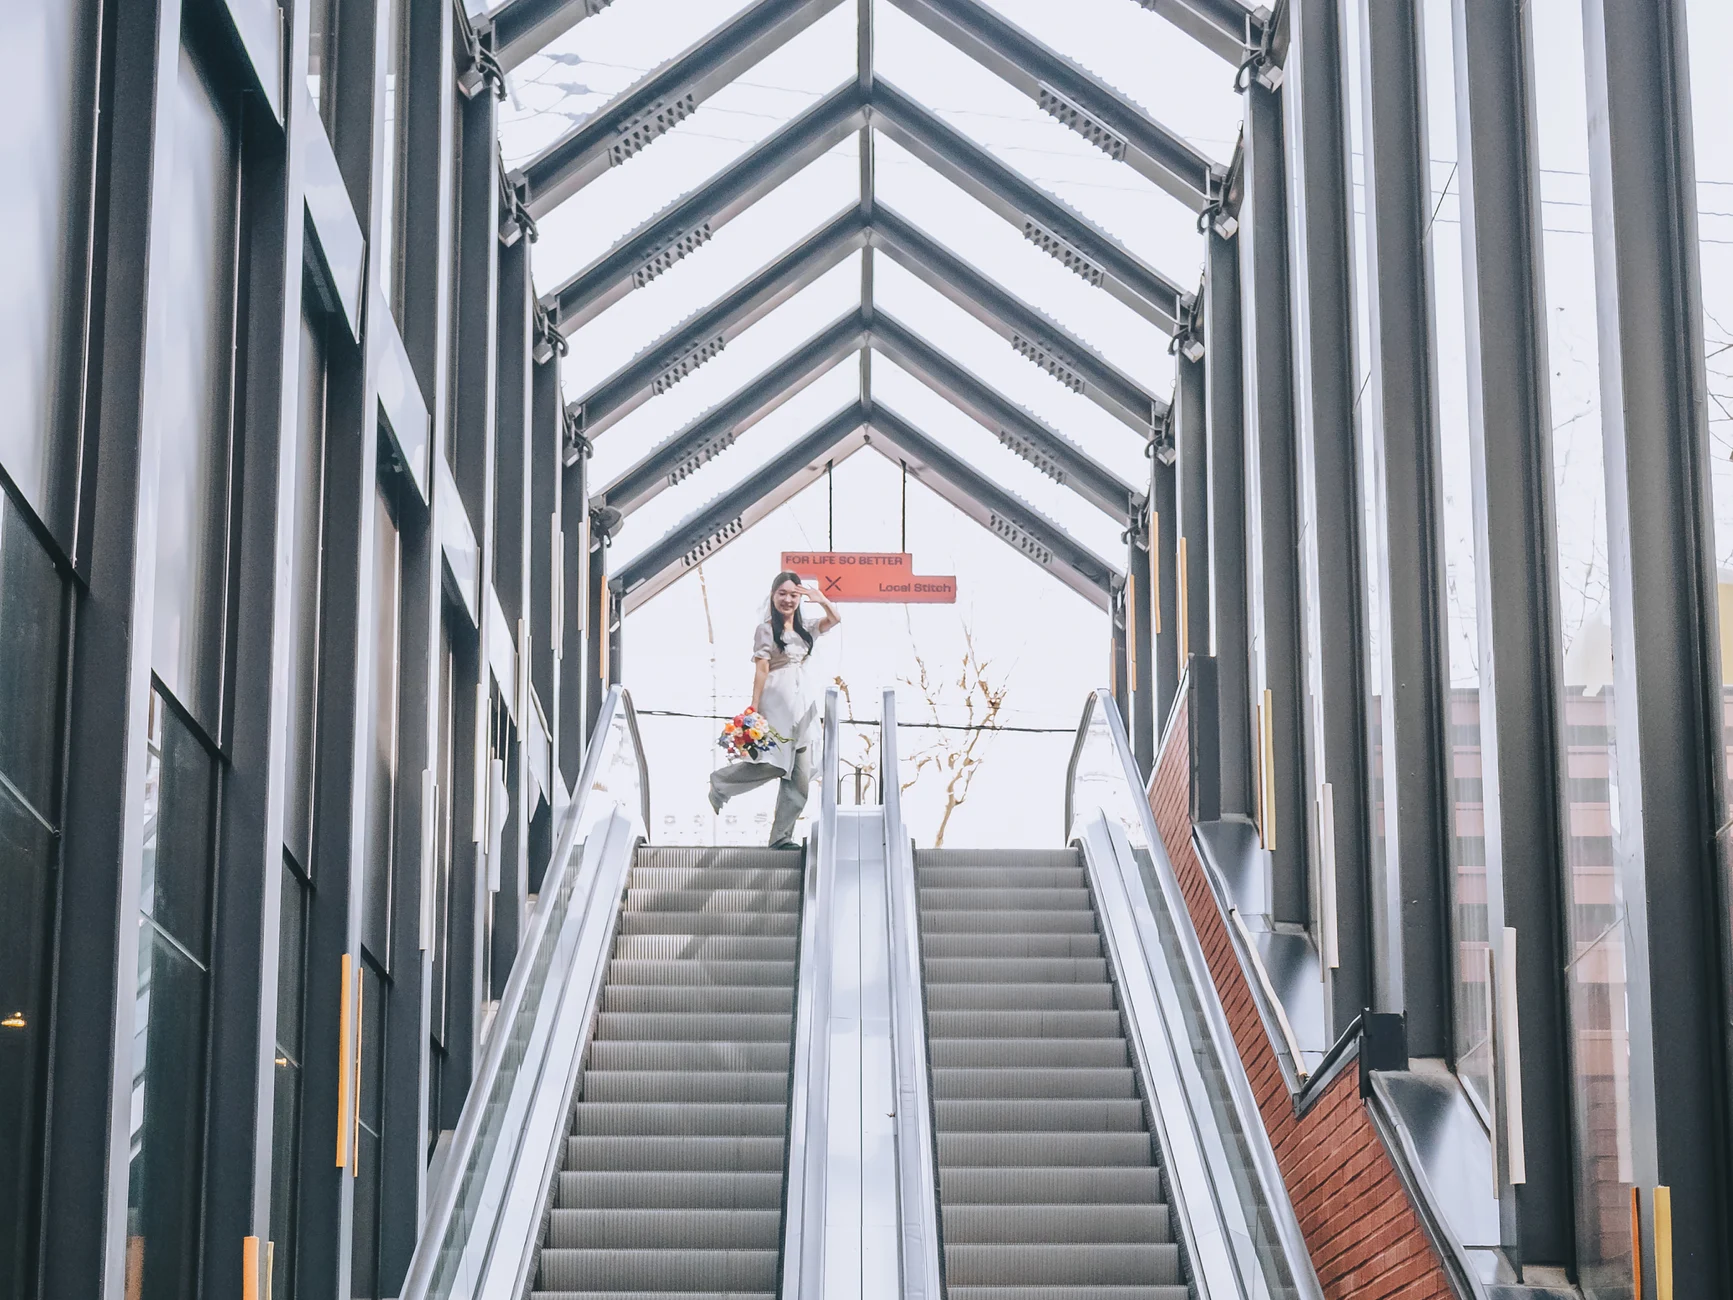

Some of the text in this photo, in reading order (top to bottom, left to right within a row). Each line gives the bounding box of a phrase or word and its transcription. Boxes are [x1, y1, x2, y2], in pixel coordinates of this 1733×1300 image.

[785, 555, 903, 566] FOR LIFE SO BETTER
[879, 583, 952, 593] Local Stitch
